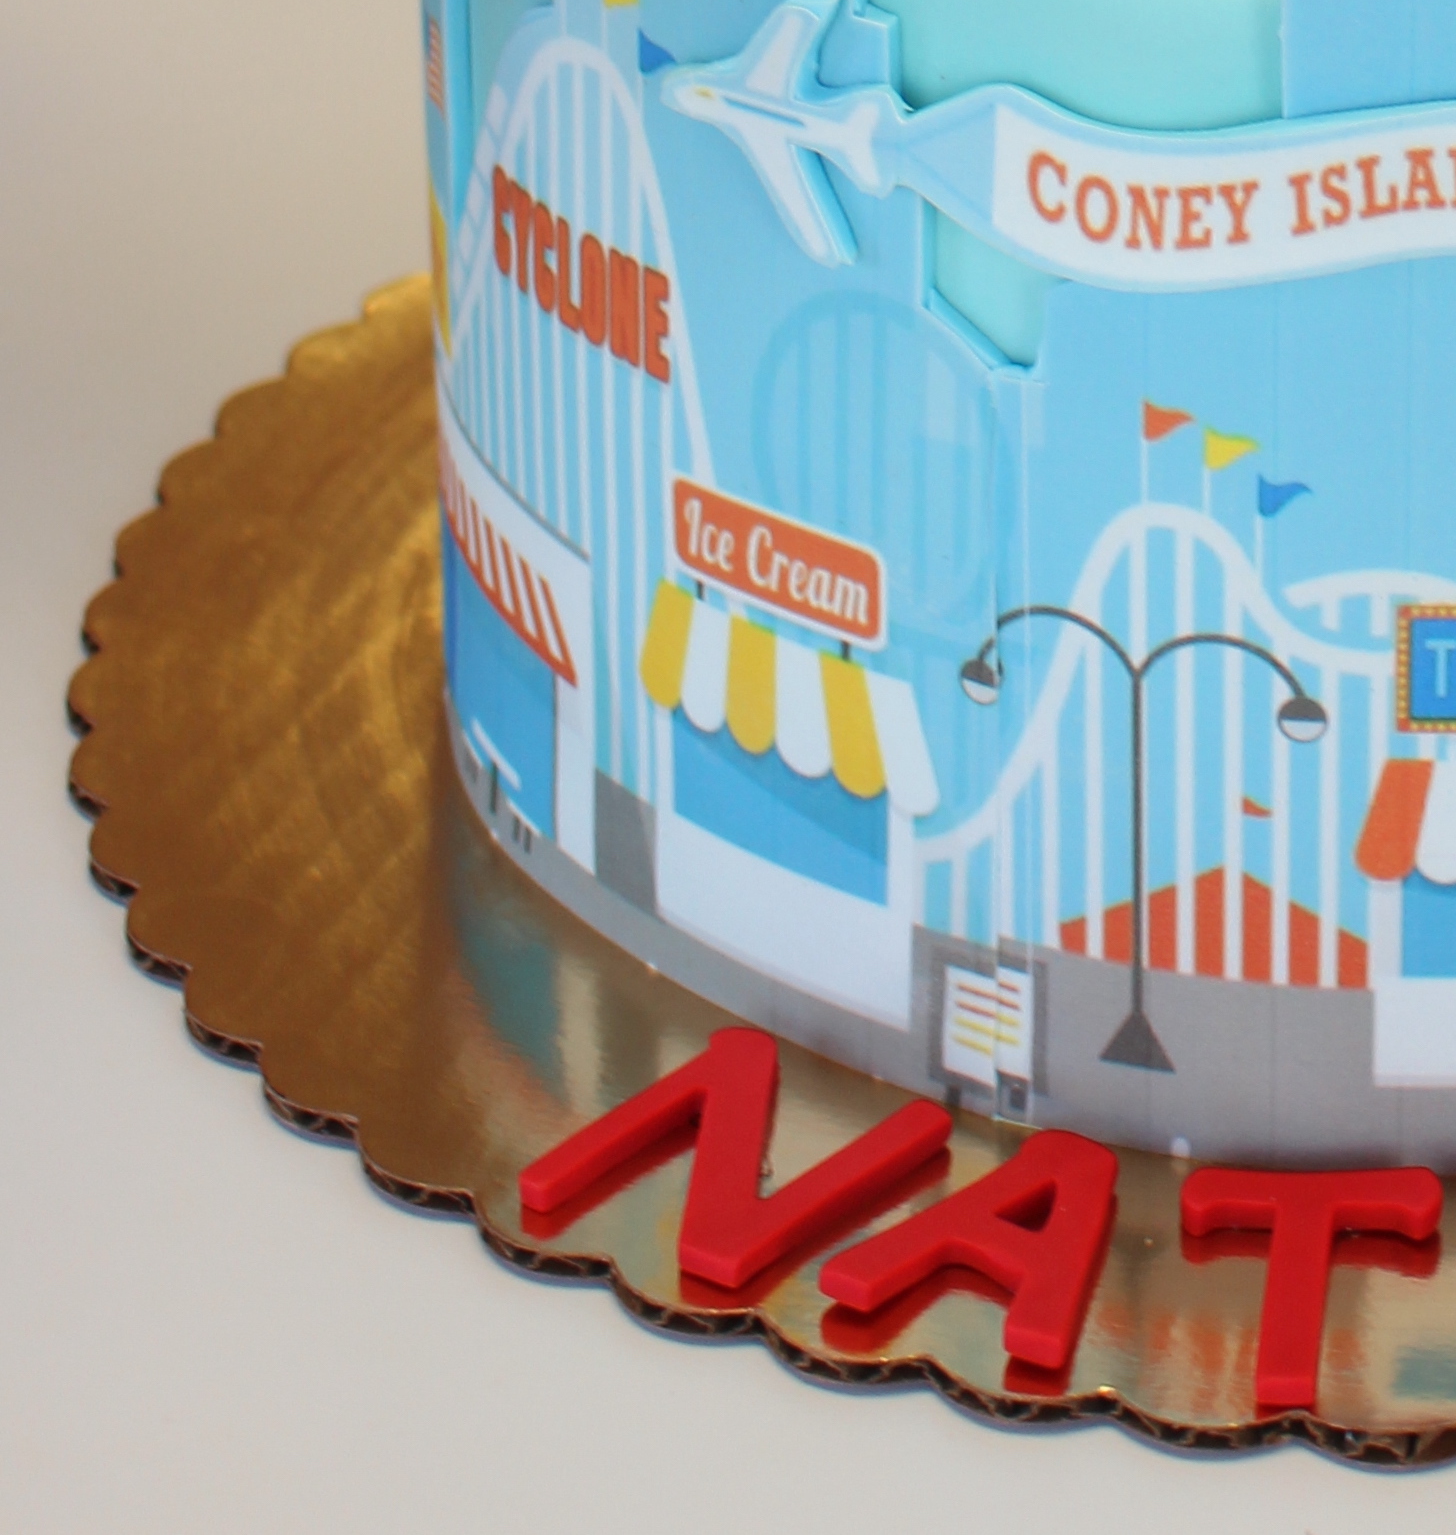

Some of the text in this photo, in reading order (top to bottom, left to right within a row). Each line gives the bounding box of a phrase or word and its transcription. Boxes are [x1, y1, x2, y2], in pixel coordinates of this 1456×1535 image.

[1026, 151, 1261, 252] CONEY
[491, 163, 671, 384] CYCLONE
[683, 496, 870, 628] Ice Cream
